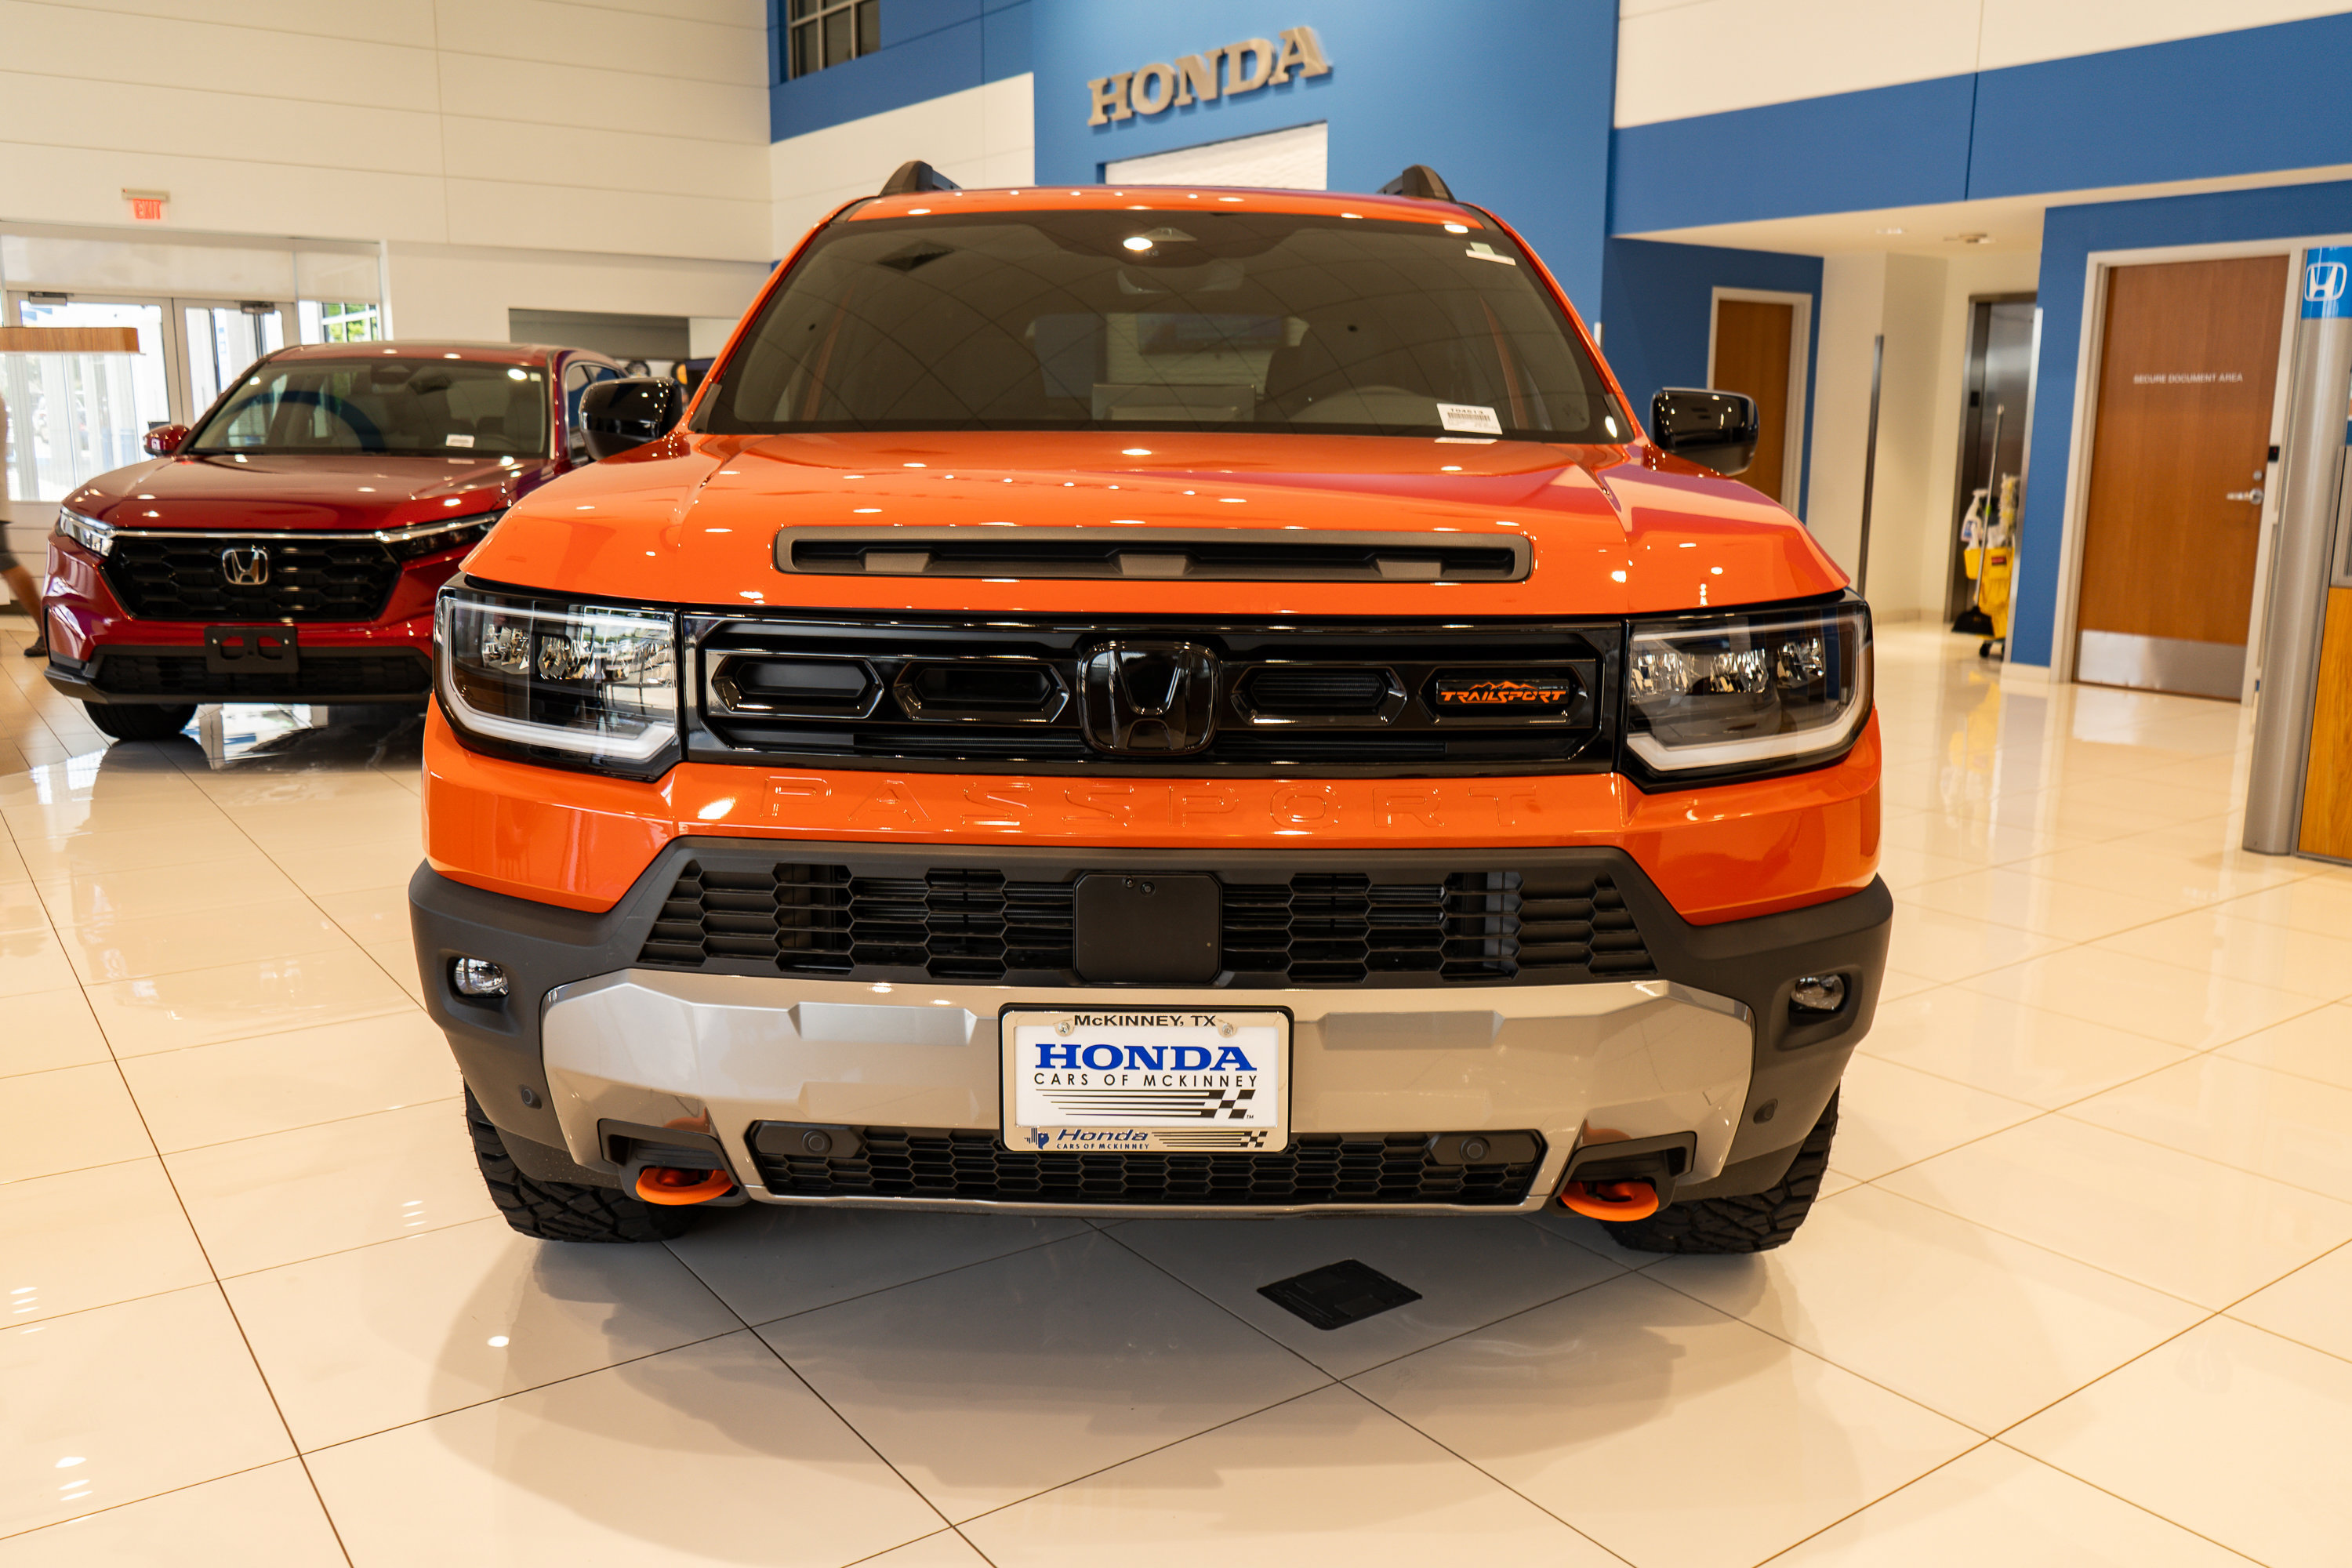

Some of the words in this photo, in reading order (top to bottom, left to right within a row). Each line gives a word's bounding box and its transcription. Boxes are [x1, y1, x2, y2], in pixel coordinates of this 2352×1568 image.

[1087, 25, 1330, 127] HONDA
[132, 198, 162, 220] EXIT
[2133, 373, 2167, 384] SECURE
[2168, 372, 2216, 383] DOCUMENT
[2218, 372, 2243, 383] AREA
[1440, 691, 1566, 703] TRAILSPORT
[760, 775, 1537, 829] PASSPORT
[1073, 1014, 1184, 1027] McKINNEY,
[1190, 1015, 1216, 1027] TX
[1035, 1044, 1258, 1071] HONDA
[1034, 1073, 1088, 1085] CARS
[1104, 1074, 1128, 1086] OF
[1143, 1075, 1258, 1087] MCKINNEY
[1056, 1129, 1149, 1141] Honda
